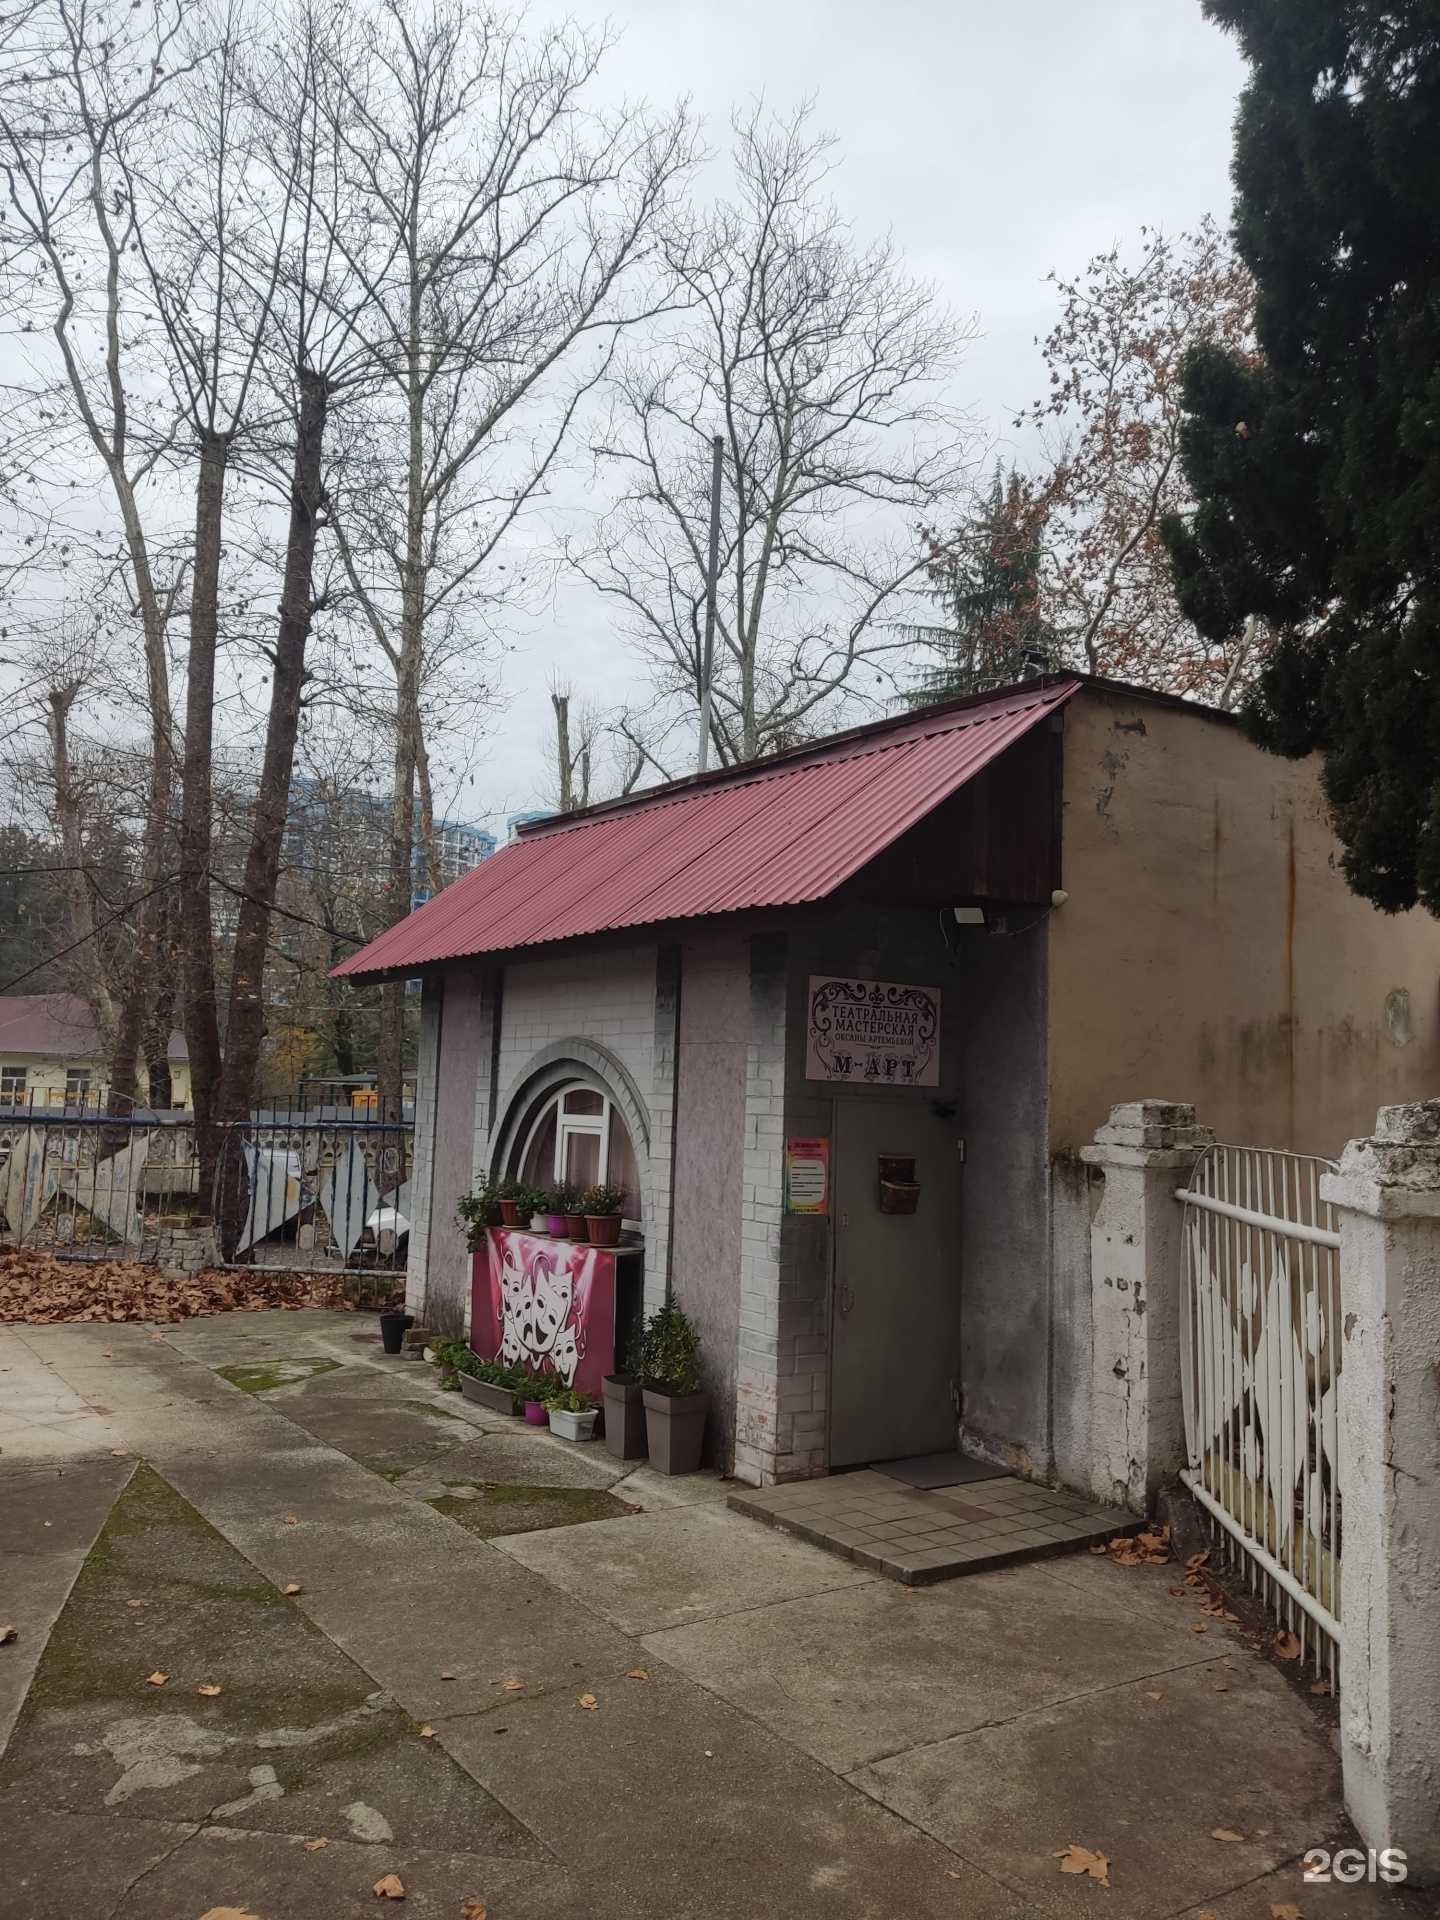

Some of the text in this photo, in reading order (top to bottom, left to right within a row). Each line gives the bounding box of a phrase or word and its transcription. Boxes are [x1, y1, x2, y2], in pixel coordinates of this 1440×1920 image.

[831, 1005, 919, 1025] ТЕАТРАЛЬНАЯ
[834, 1019, 914, 1036] МАСТЕРСКАЯ
[833, 1055, 917, 1079] М-АРТ
